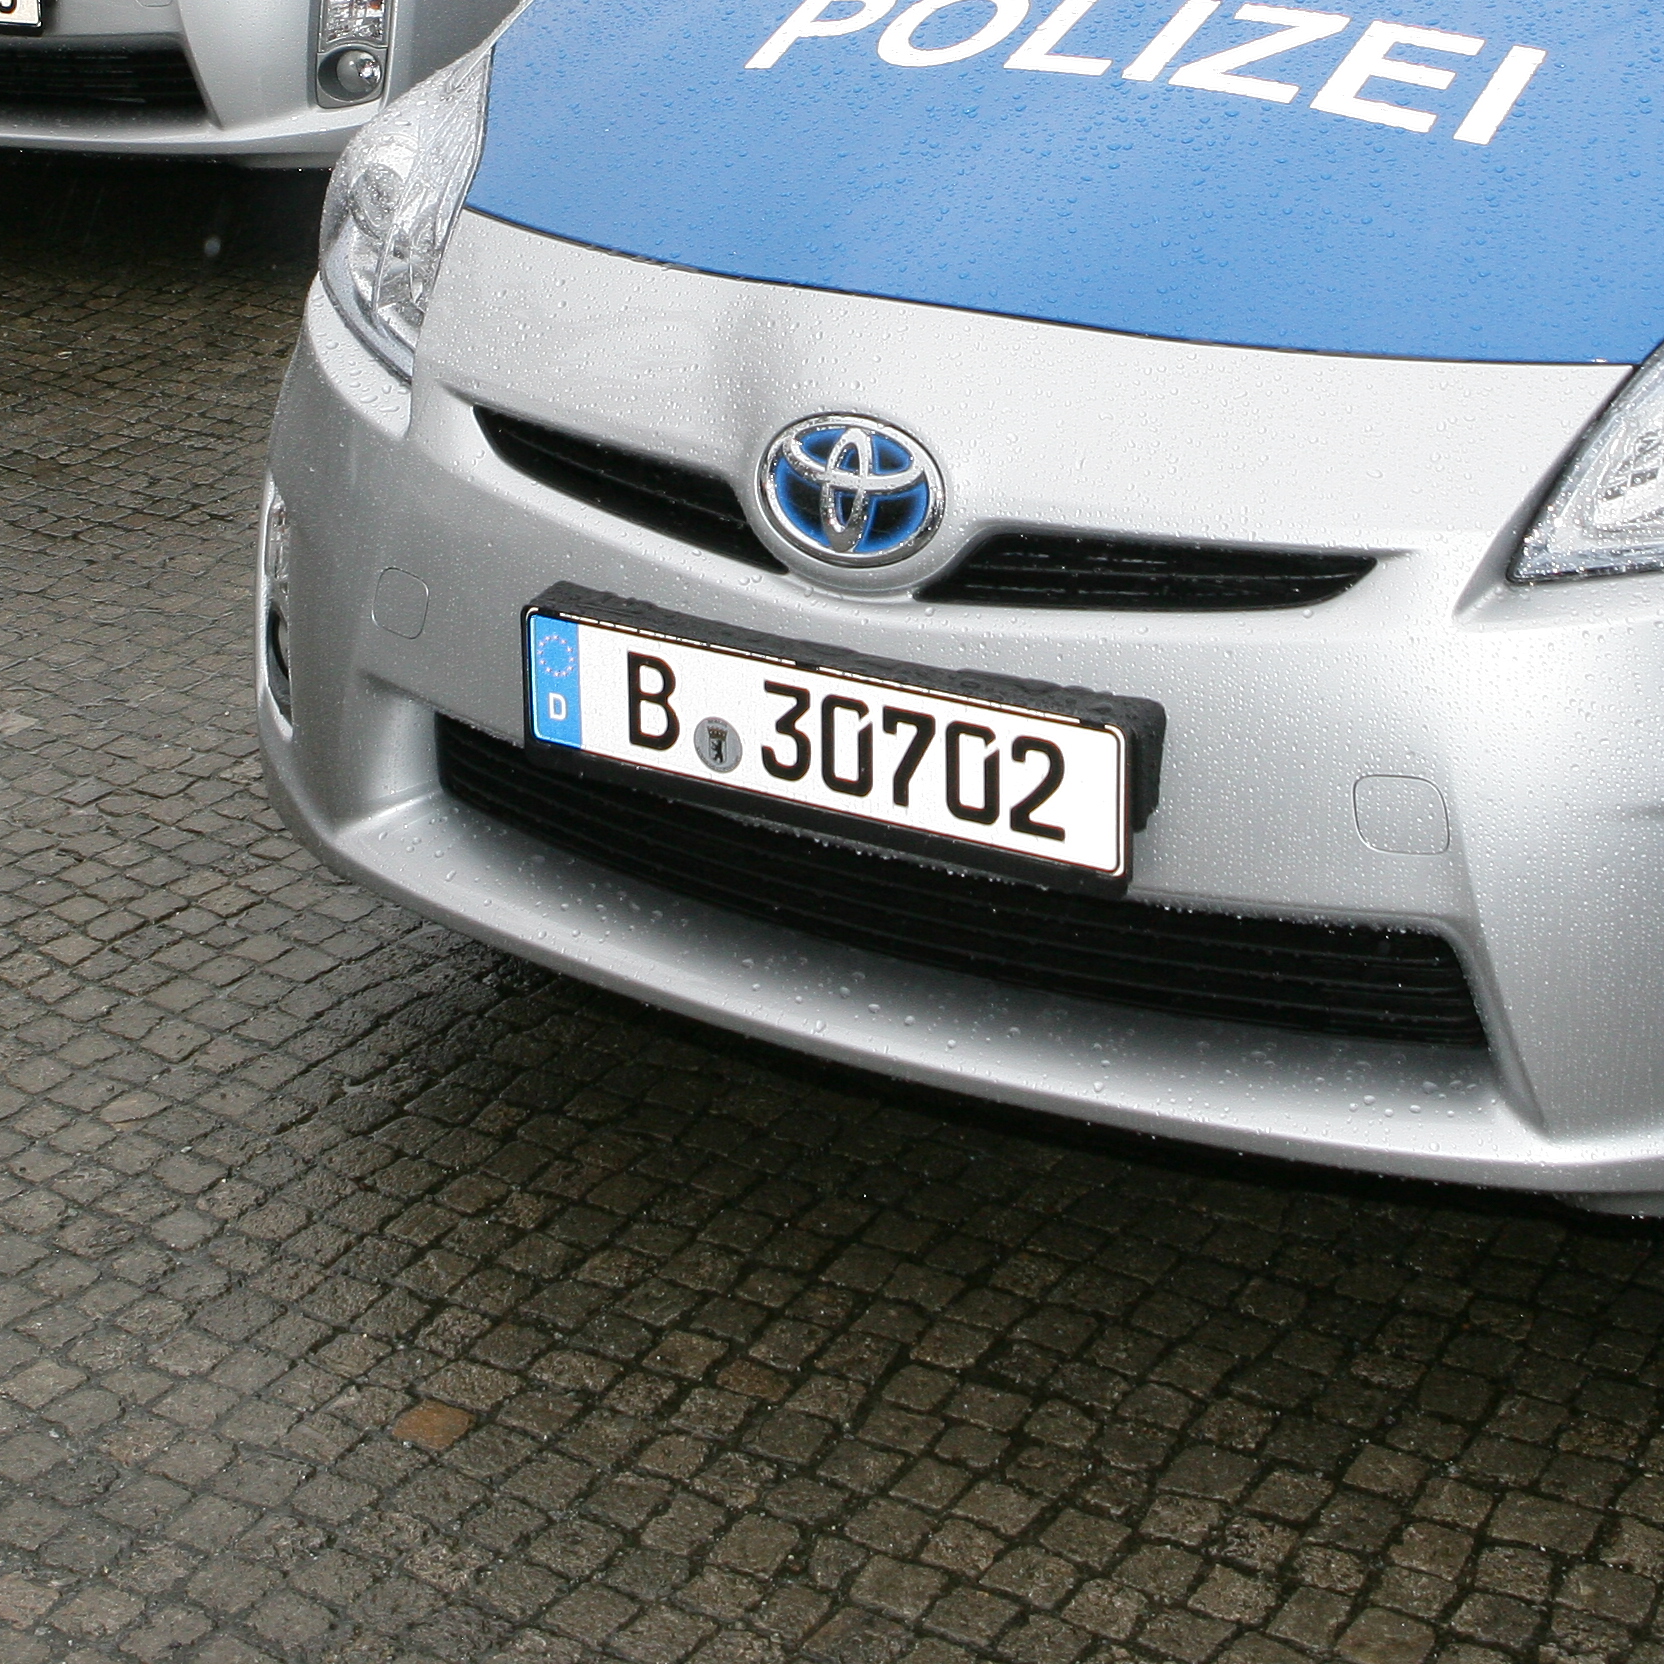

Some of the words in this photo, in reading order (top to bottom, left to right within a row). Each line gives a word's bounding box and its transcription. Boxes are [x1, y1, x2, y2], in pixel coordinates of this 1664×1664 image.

[549, 691, 567, 721] D
[626, 652, 680, 751] B
[761, 681, 1066, 842] 30702
